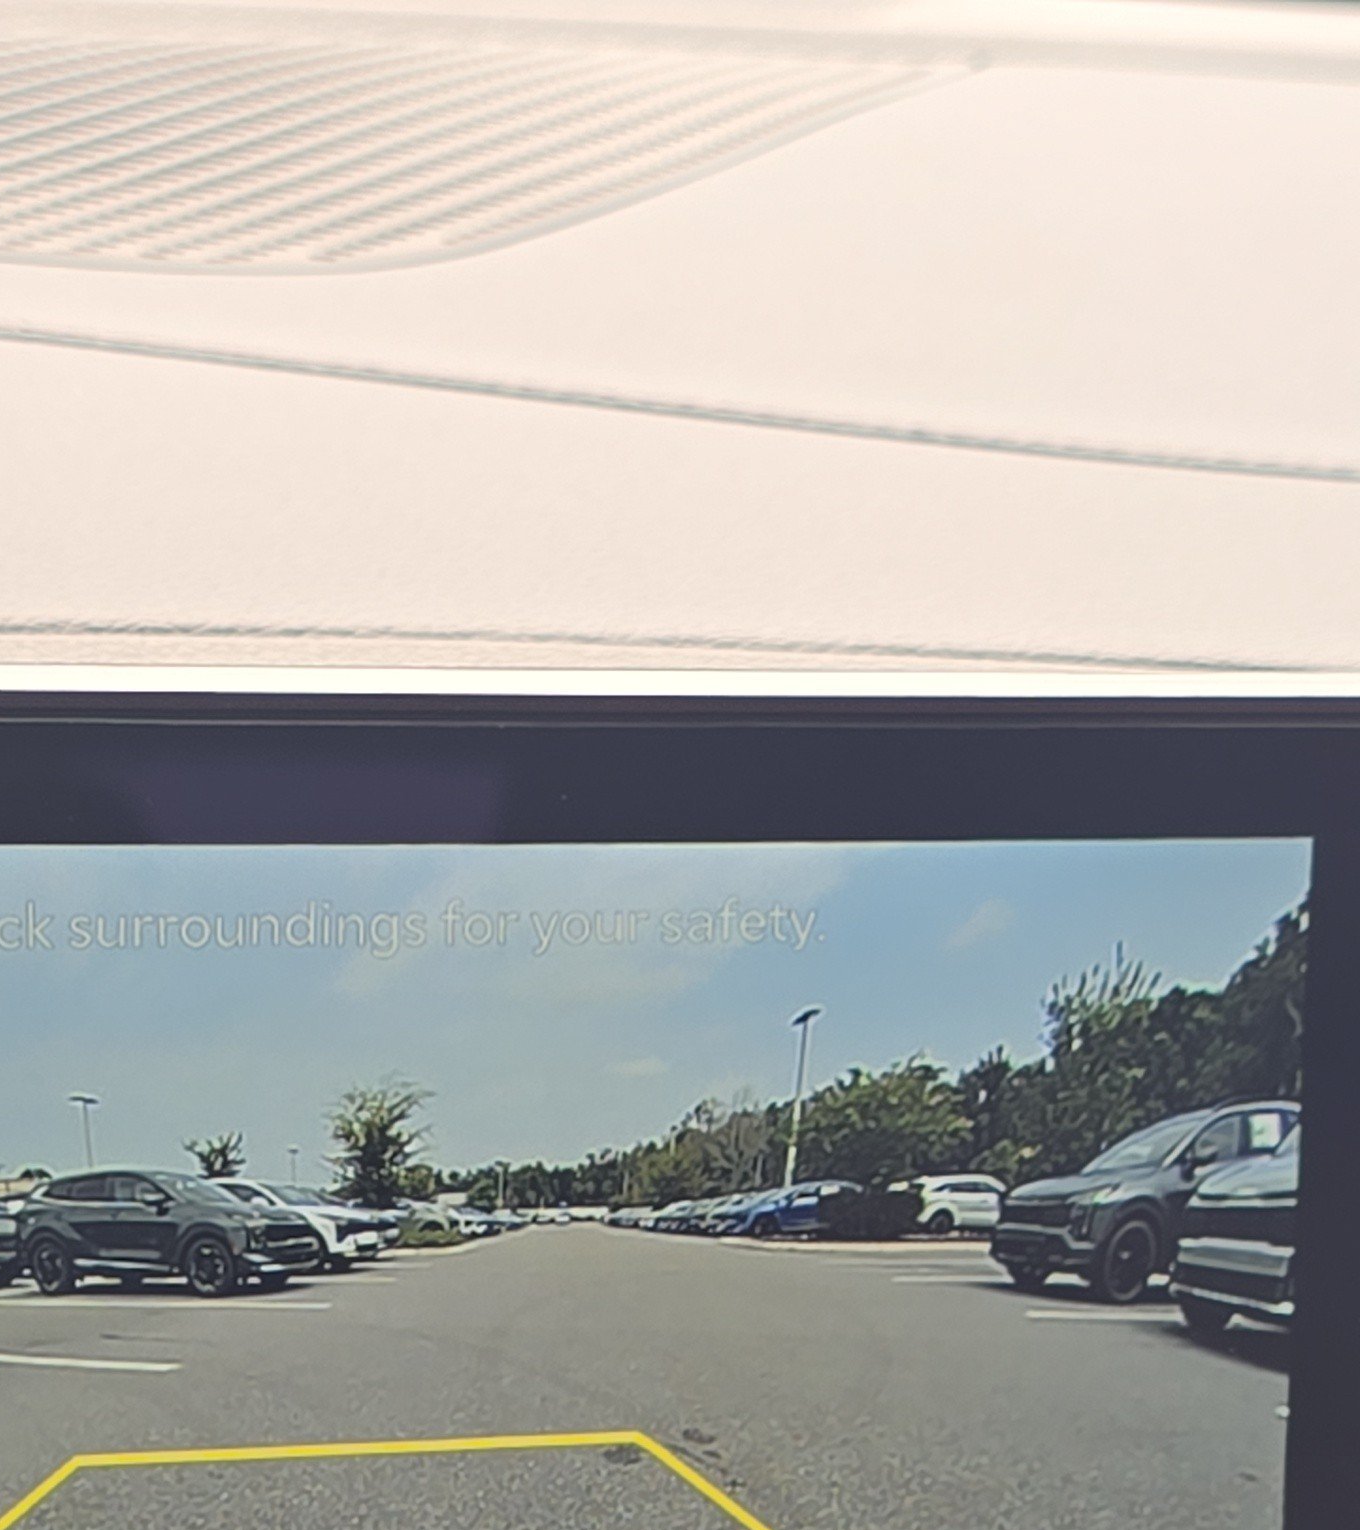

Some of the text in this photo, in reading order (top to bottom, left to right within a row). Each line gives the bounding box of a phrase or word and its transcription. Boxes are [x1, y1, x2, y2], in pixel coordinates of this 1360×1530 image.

[69, 899, 426, 957] surroundings
[442, 898, 519, 946] for
[530, 910, 649, 956] your
[661, 897, 827, 951] safety.
